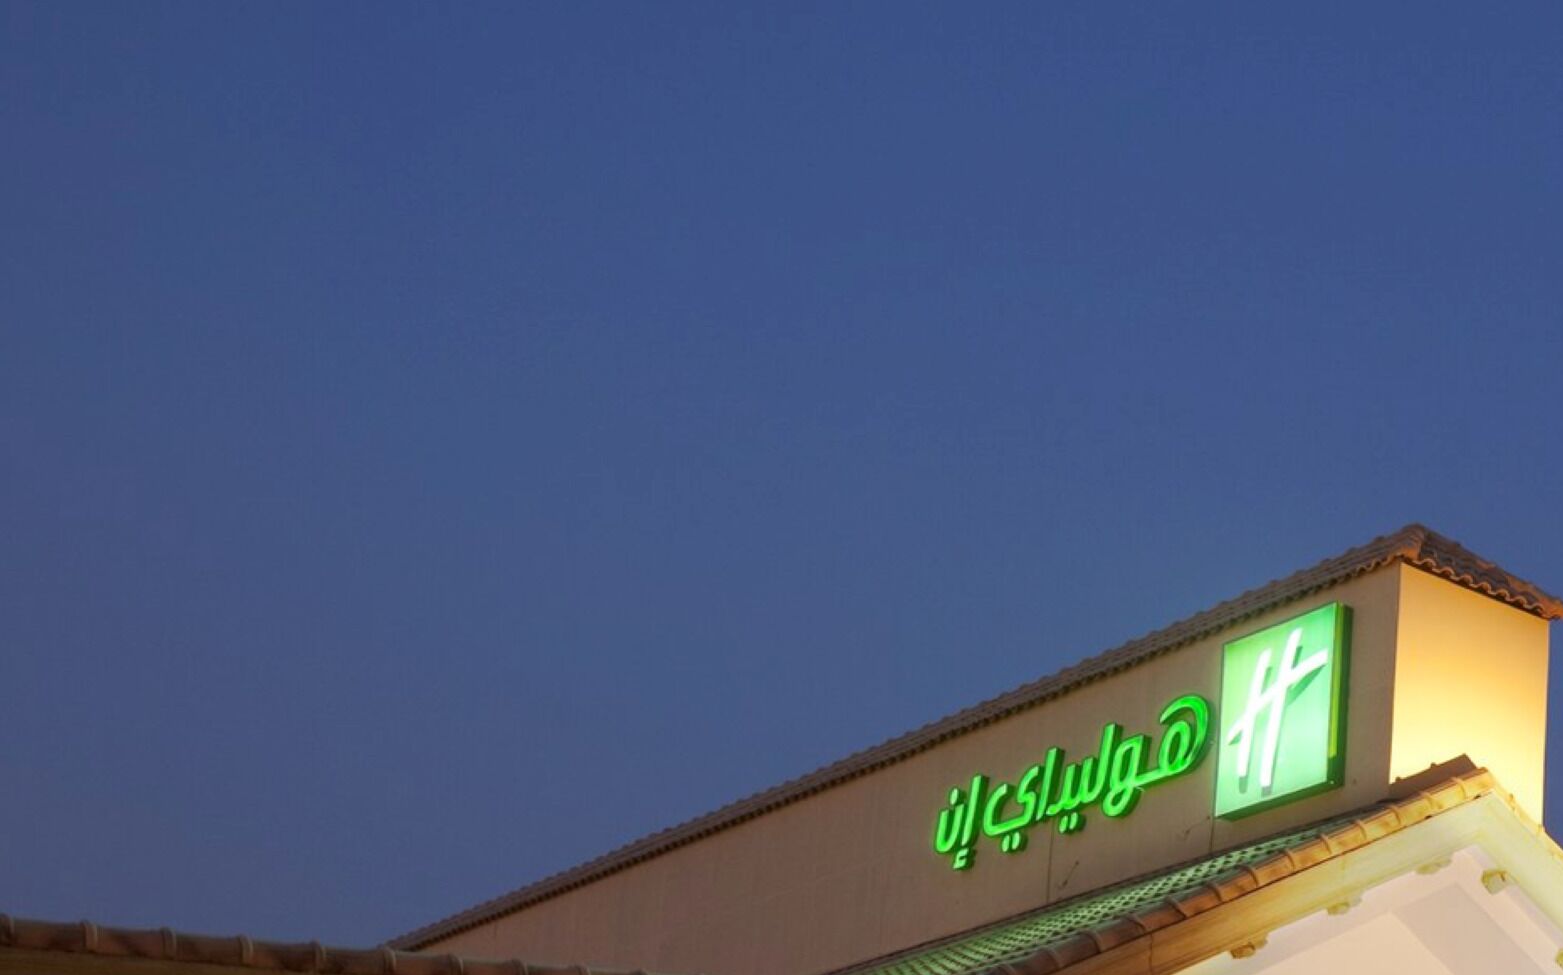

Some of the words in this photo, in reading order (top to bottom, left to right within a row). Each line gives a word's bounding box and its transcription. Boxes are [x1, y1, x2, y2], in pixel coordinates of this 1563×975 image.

[983, 694, 1213, 853] هوليداي
[1228, 628, 1328, 787] H
[934, 774, 987, 870] إن
